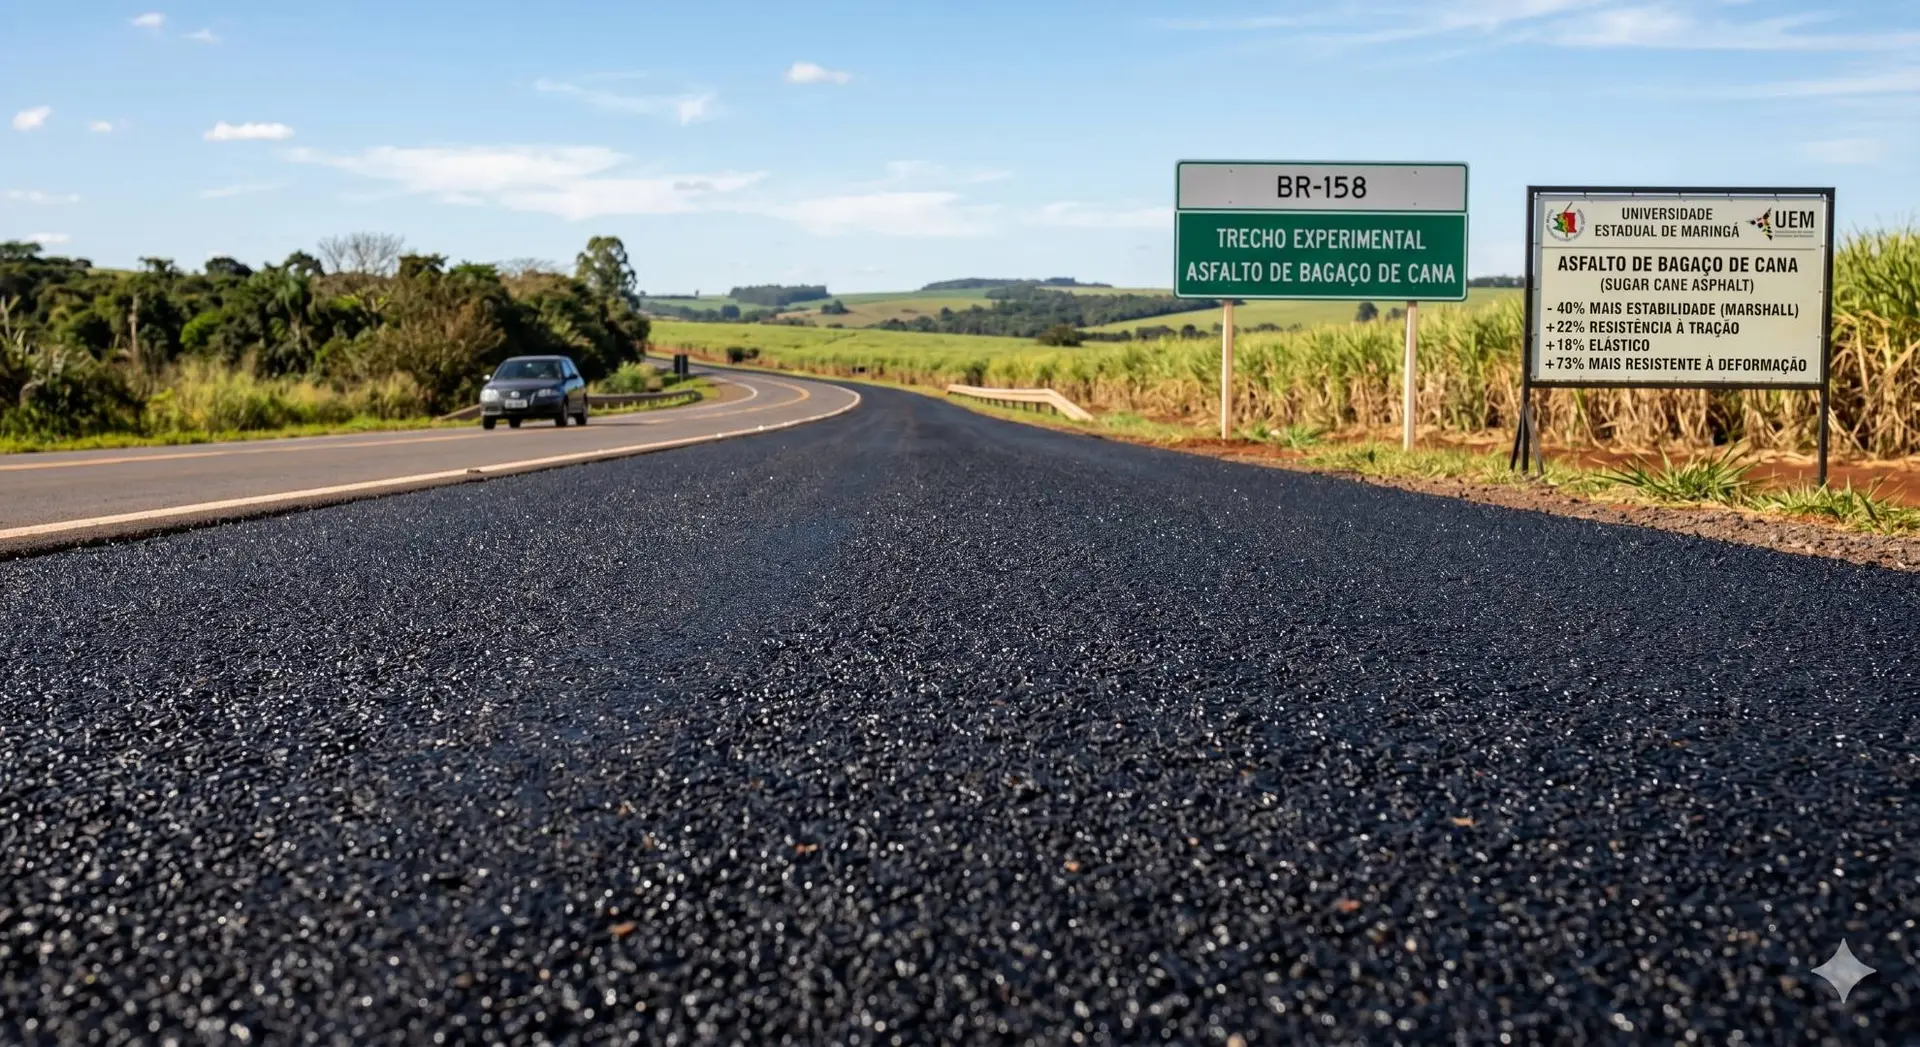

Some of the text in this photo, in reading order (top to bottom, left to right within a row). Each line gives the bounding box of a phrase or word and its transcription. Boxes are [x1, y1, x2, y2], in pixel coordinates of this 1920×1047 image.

[1278, 176, 1366, 198] BR-158
[1622, 208, 1713, 220] UNIVERSIDADE
[1775, 211, 1814, 228] UEM
[1595, 222, 1739, 237] ESTADUAL DE MARINGÁ
[1217, 228, 1426, 249] TRECHO EXPERIMENTAL
[1187, 262, 1455, 286] ASFALTO DE BAGAÇO DE CANA
[1558, 256, 1798, 276] ASFALTO DE BAGAÇO DE CANA
[1601, 278, 1753, 294] (SUGAR CANE ASPHALT)
[1557, 302, 1585, 314] 40%
[1590, 302, 1621, 314] MAIS
[1627, 302, 1715, 315] ESTABILIDADE
[1721, 303, 1798, 319] (MARSHALL)
[1590, 319, 1672, 334] RESISTÊNCIA
[1676, 319, 1684, 334] À
[1689, 319, 1740, 337] TRAÇÃO
[1590, 336, 1649, 351] ELÁSTICO
[1589, 358, 1621, 370] MAIS
[1626, 358, 1701, 370] RESISTENTE
[1706, 355, 1713, 370] À
[1719, 357, 1806, 374] DEFORMAÇÃO
